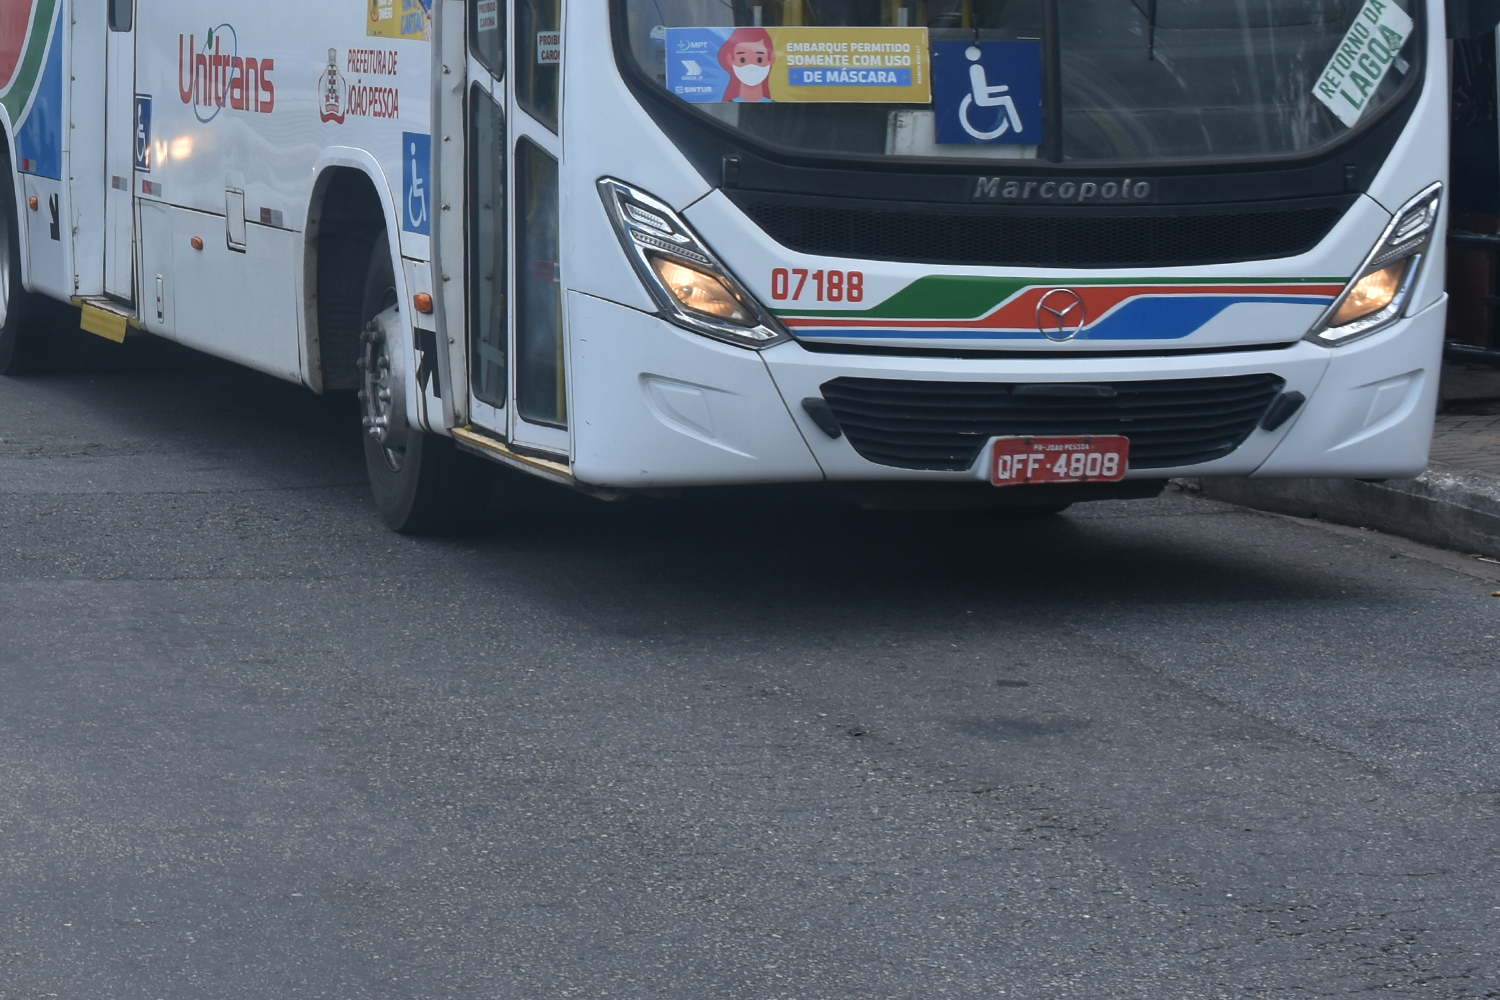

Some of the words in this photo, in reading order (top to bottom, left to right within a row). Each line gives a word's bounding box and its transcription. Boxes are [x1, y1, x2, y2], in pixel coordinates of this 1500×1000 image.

[347, 48, 387, 74] PREFEITURA
[387, 50, 398, 75] DE
[786, 42, 848, 54] EMBARQUE
[850, 43, 911, 53] PERMITIDO
[787, 54, 849, 66] SOMENTE
[852, 55, 881, 66] COM
[885, 55, 911, 67] USO
[1318, 21, 1370, 99] RETORNO
[178, 27, 275, 113] Unitrans
[803, 71, 822, 83] DE
[826, 67, 898, 83] MÁSCARA
[1339, 23, 1403, 111] LAGOA
[346, 79, 368, 116] JOÃO
[368, 87, 399, 119] PESSOA
[973, 176, 1150, 202] Marcopolo
[771, 267, 864, 302] 07188
